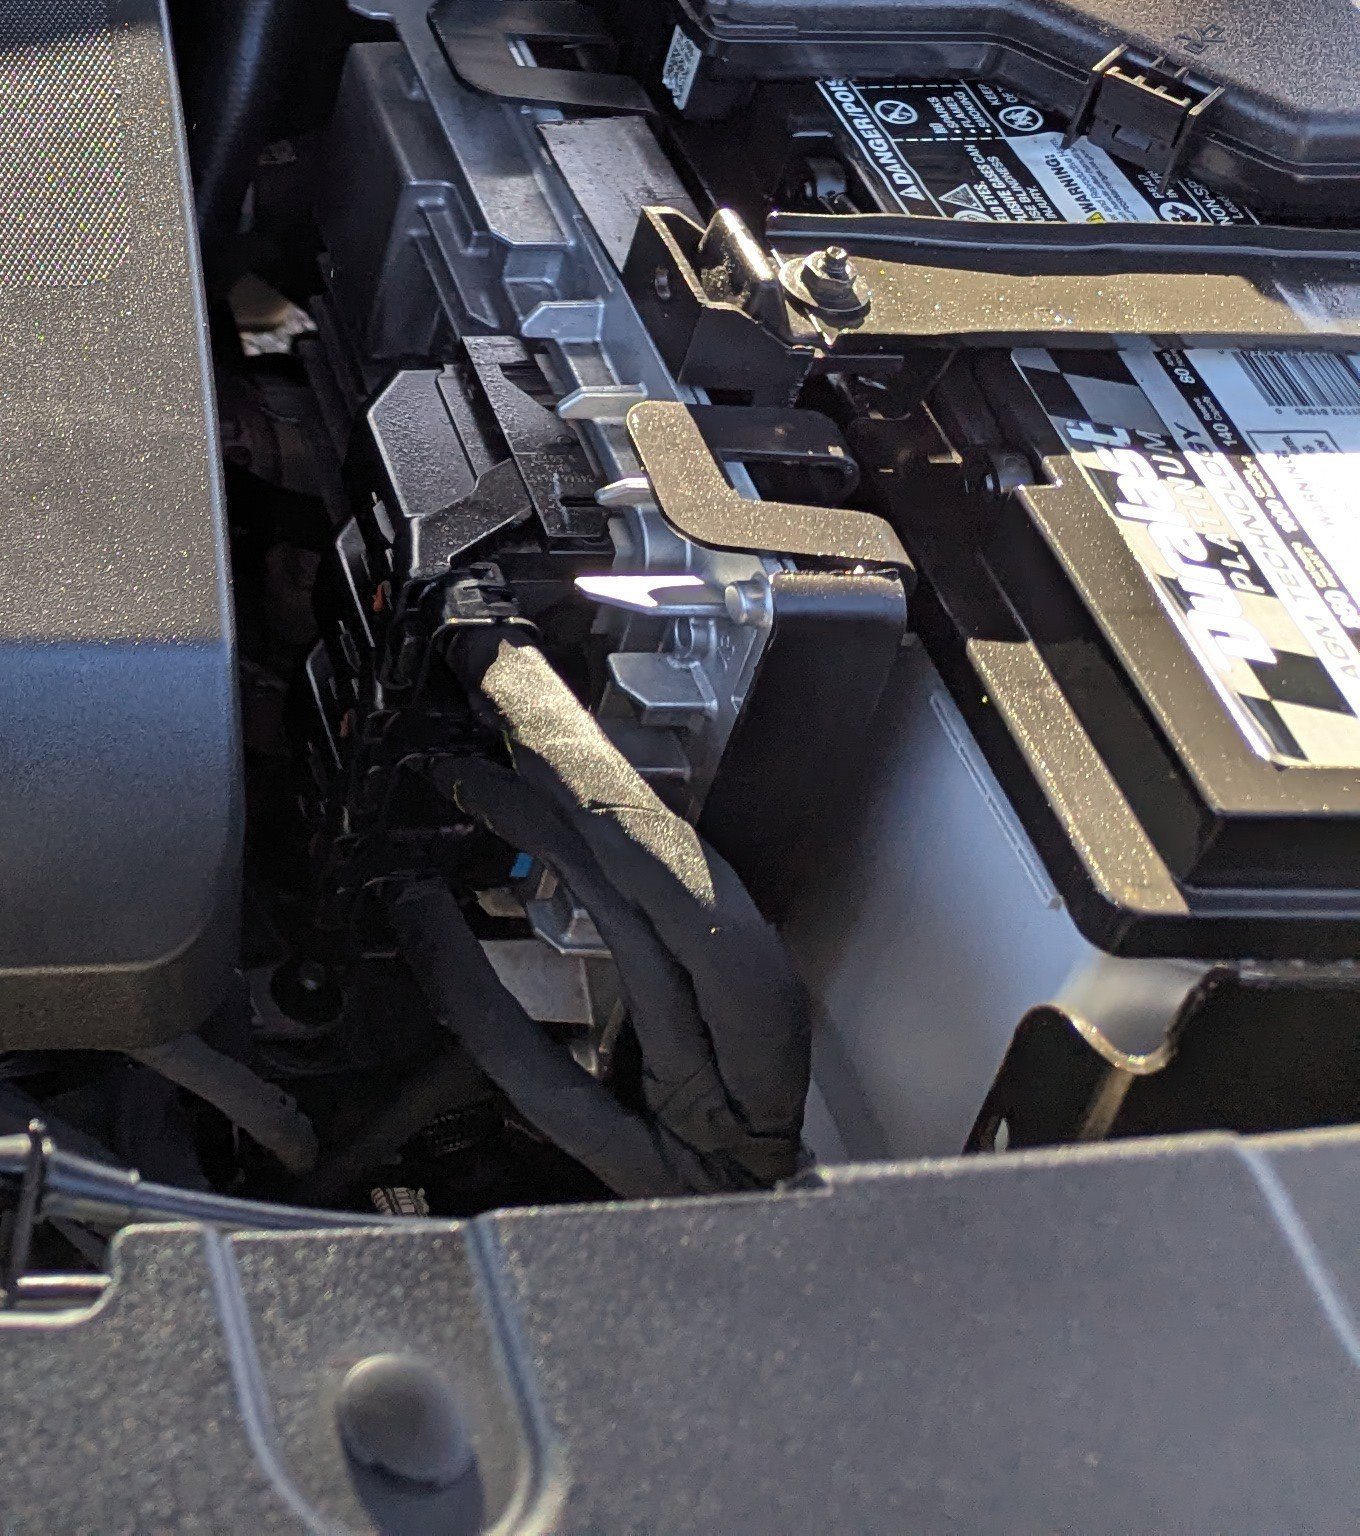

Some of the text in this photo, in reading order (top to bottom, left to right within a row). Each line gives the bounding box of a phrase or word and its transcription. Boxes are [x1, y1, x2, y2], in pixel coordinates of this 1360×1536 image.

[942, 96, 975, 129] FLAMES
[954, 91, 990, 128] SMOKING
[1044, 153, 1098, 214] WARNING:
[1212, 423, 1238, 447] 140
[1134, 428, 1267, 594] PLATINUM
[1174, 421, 1309, 603] TECHNOLOGY
[1065, 420, 1278, 672] Duralast
